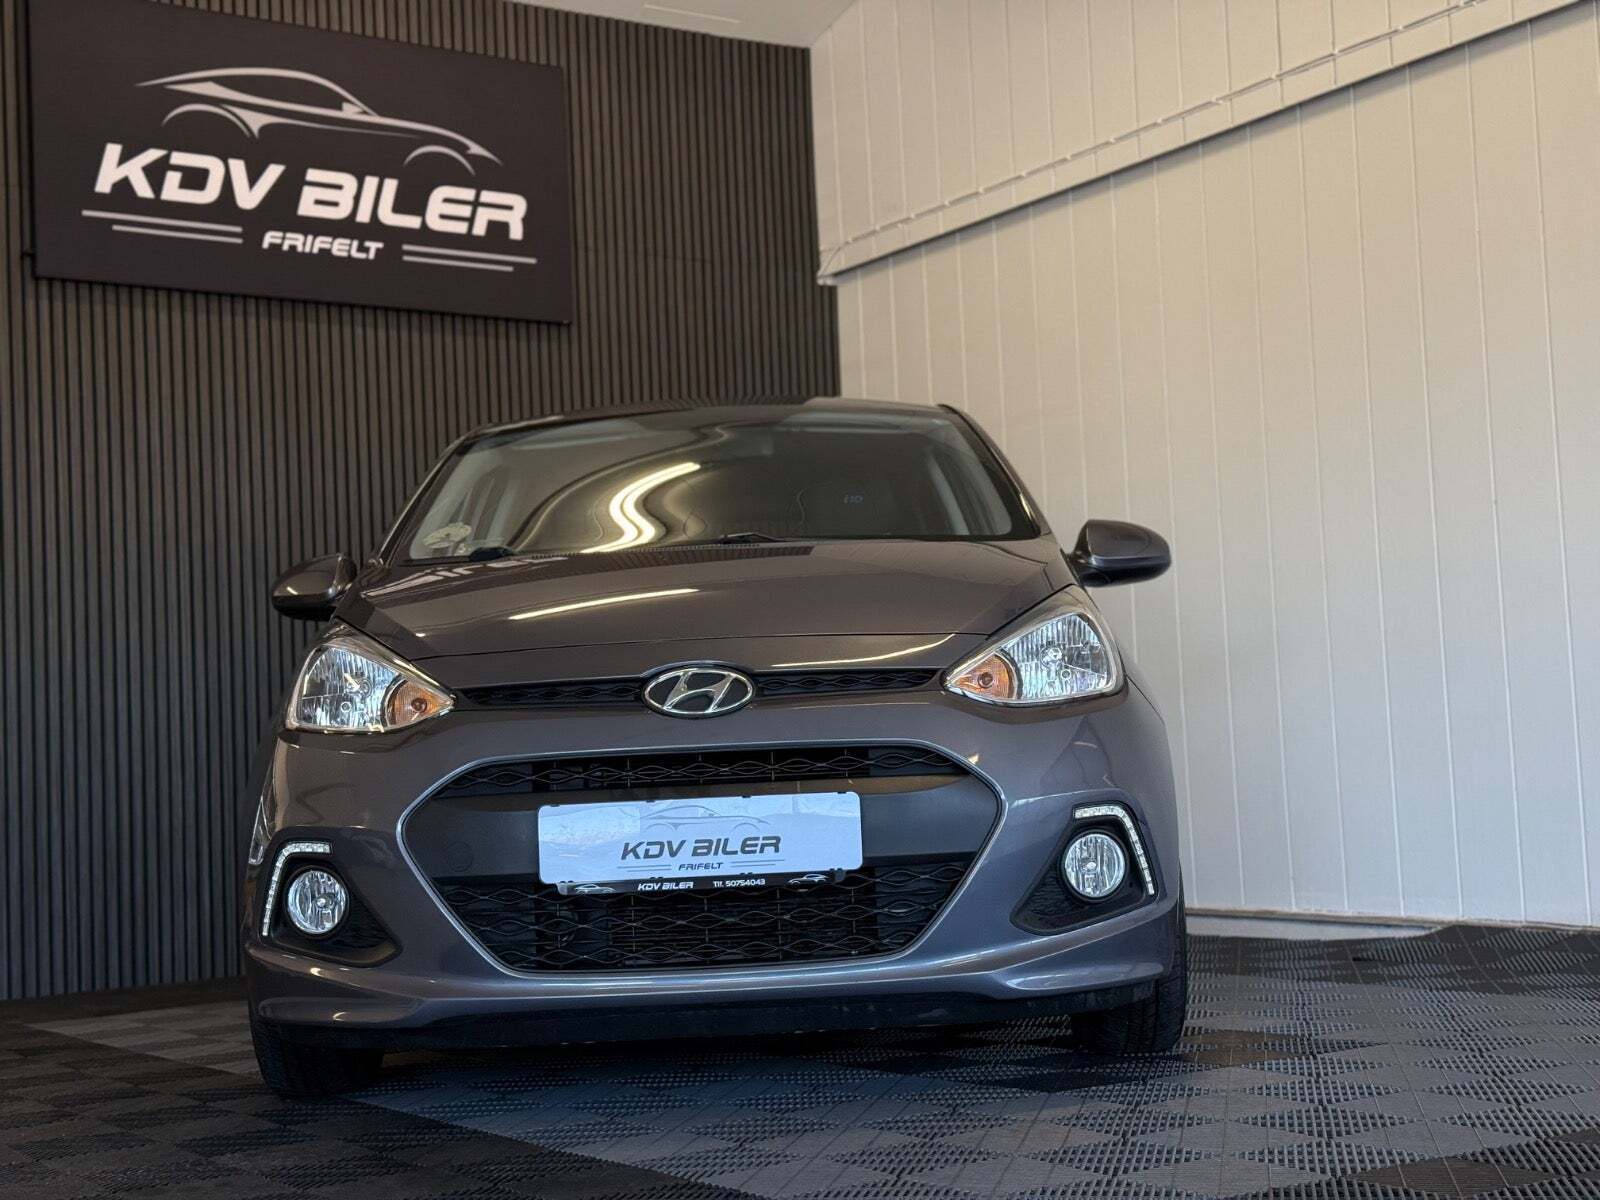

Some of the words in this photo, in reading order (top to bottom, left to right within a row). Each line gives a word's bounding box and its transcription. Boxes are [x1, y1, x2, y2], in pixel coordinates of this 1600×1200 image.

[94, 142, 287, 211] KDV
[297, 167, 528, 241] BILER
[261, 230, 384, 261] FRIFELT
[620, 839, 687, 861] KDV
[691, 835, 781, 857] BILER
[678, 862, 724, 871] FRIFELT
[637, 882, 661, 892] KDV
[661, 881, 694, 891] BILER
[725, 878, 766, 888] 50754043
